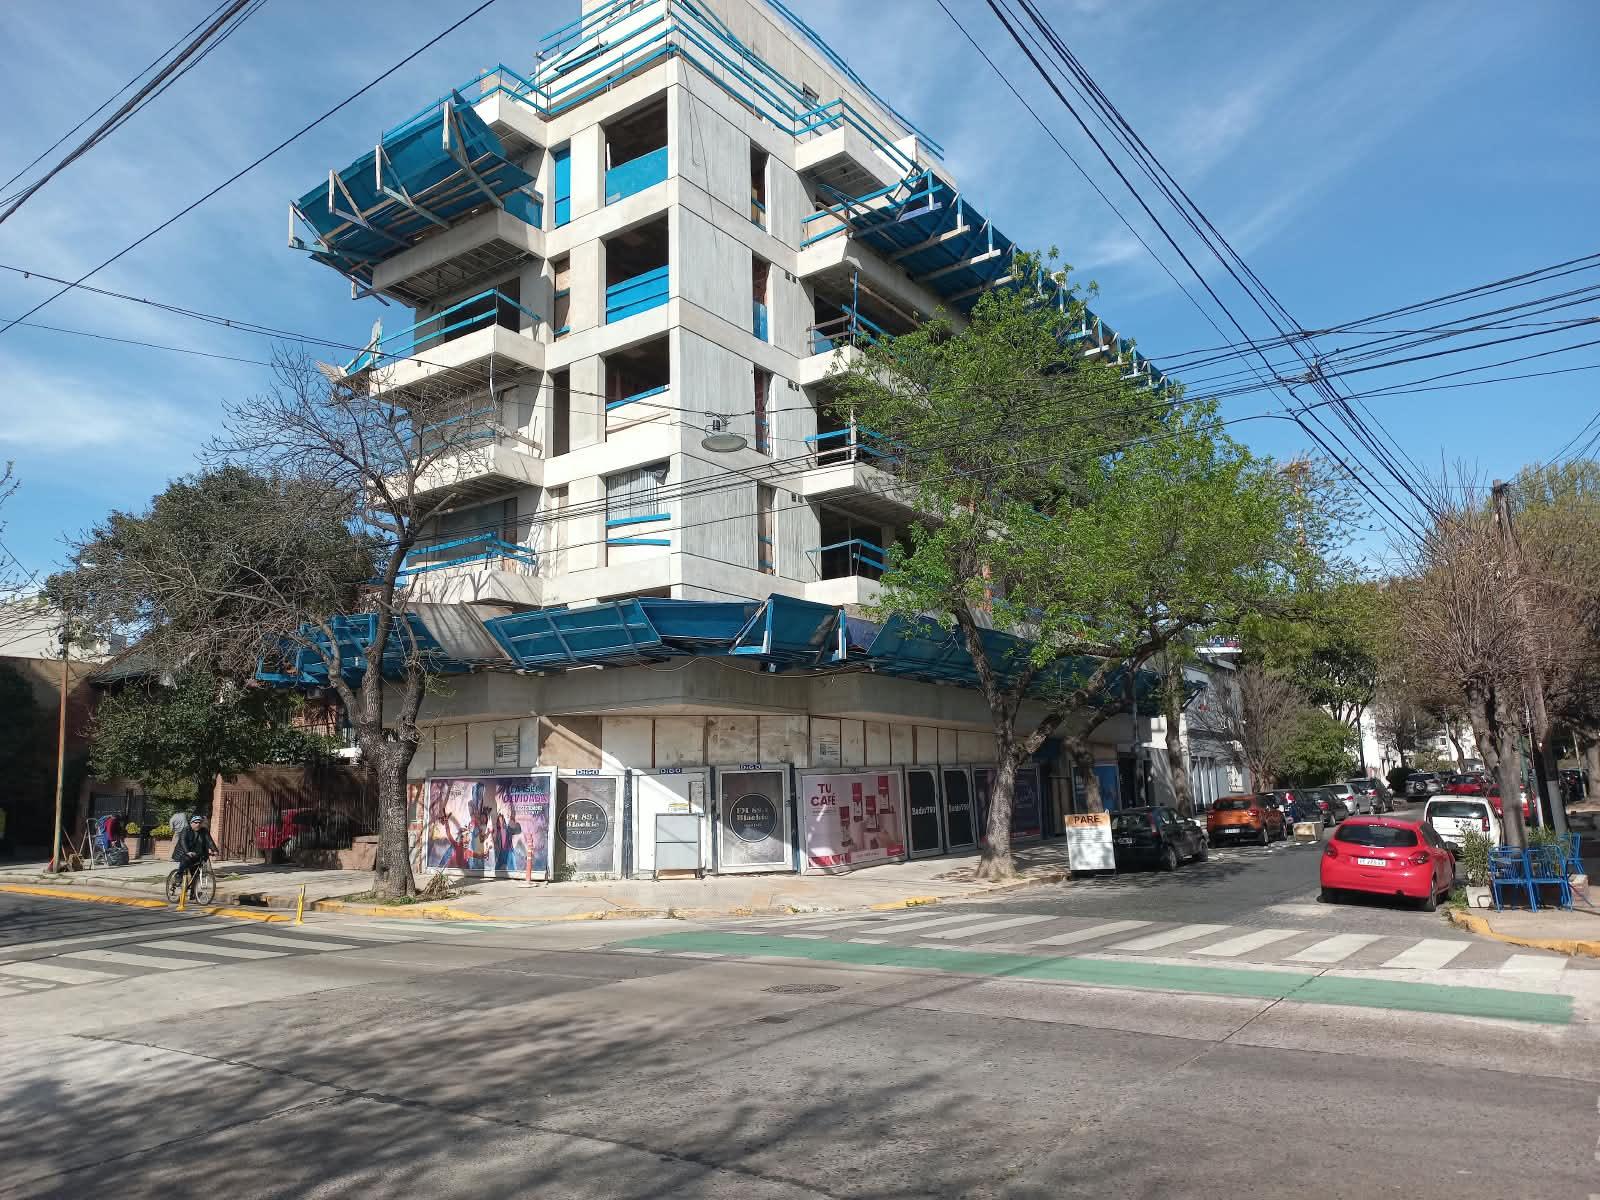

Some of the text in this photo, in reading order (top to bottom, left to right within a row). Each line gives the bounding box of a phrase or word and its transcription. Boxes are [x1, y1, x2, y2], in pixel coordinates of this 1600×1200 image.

[817, 783, 832, 794] TU
[810, 792, 836, 807] CAFÉ
[1074, 815, 1100, 824] PARE
